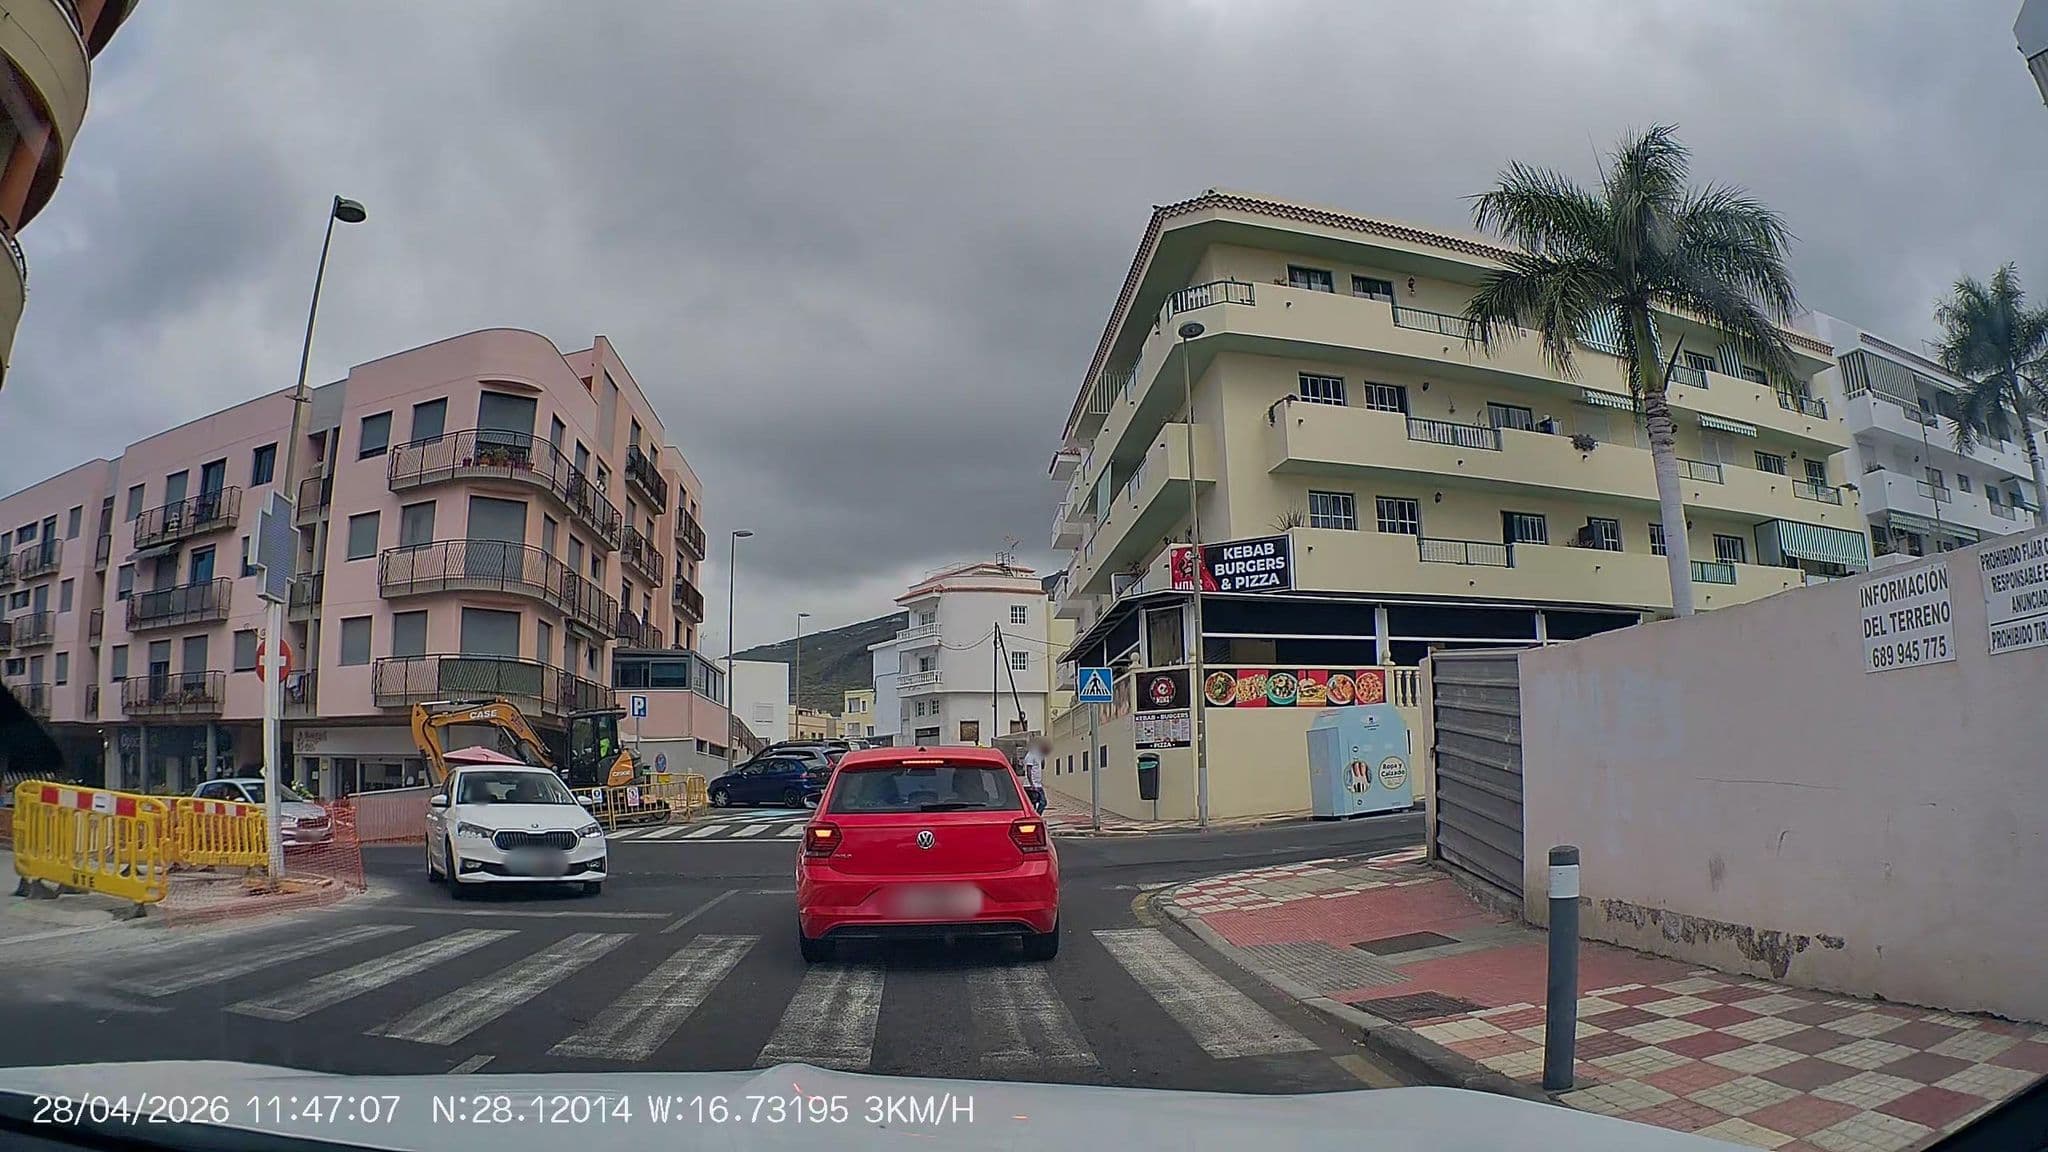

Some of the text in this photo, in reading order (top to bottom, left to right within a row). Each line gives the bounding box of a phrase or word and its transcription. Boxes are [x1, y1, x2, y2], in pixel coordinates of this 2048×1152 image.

[1214, 556, 1285, 577] BURGERS
[1223, 543, 1275, 560] KEBAB
[1980, 545, 2021, 572] PROHIBIDO
[2022, 539, 2044, 561] FIJAR
[1221, 572, 1280, 591] & PIZZA
[1860, 565, 1948, 609] INFORMACIÓN
[1991, 565, 2043, 593] RESPONSABLE
[1863, 601, 1950, 639] DEL TERRENO
[1991, 620, 2048, 652] PROHIBIDO TIR
[1872, 635, 1947, 668] 689 945 775
[469, 709, 498, 720] CASE
